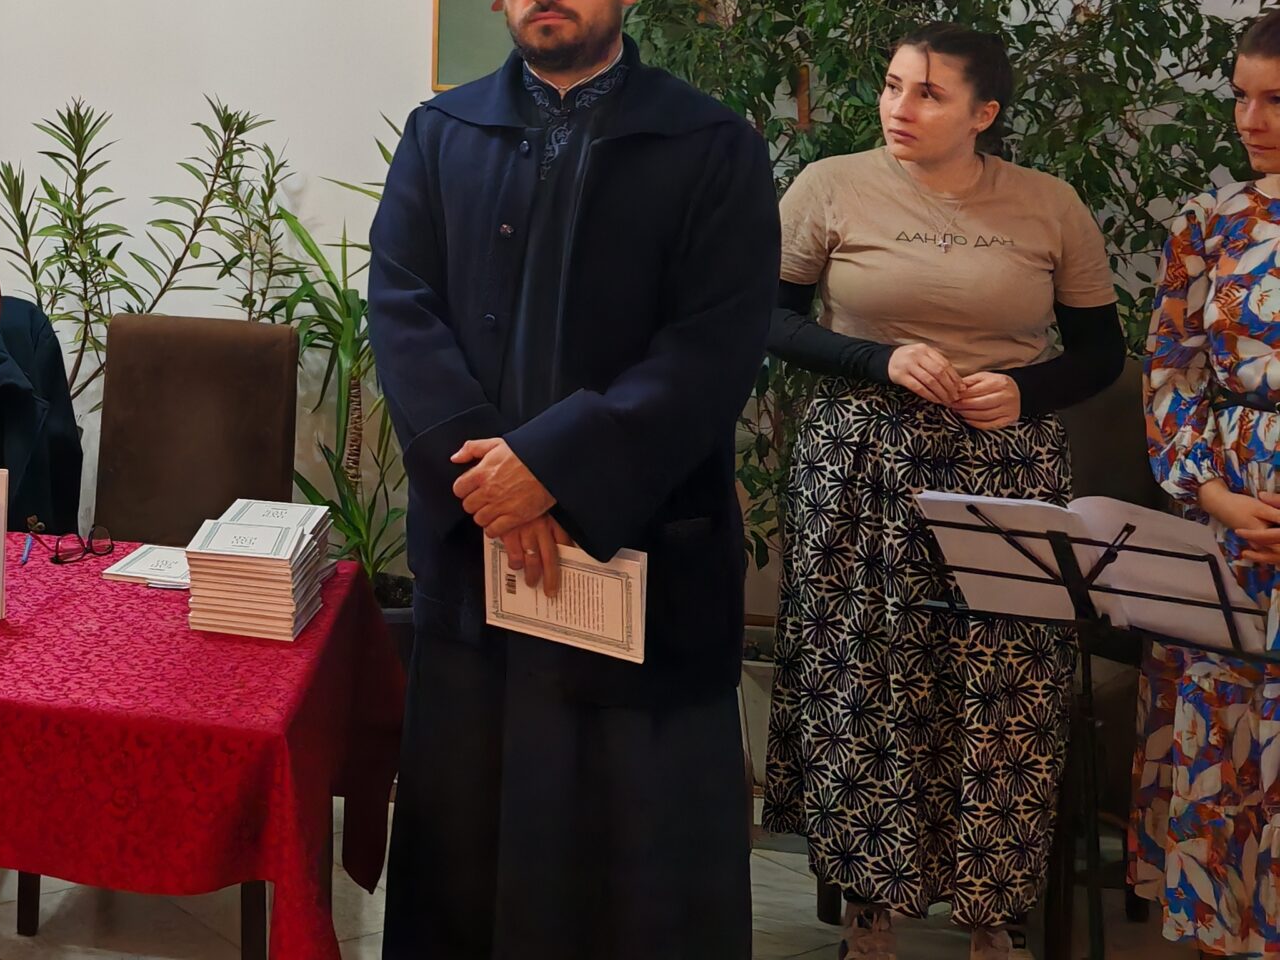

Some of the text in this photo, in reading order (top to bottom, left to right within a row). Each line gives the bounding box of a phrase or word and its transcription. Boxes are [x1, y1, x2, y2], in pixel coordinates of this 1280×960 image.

[895, 231, 1015, 248] ДАН ПО ДАН
